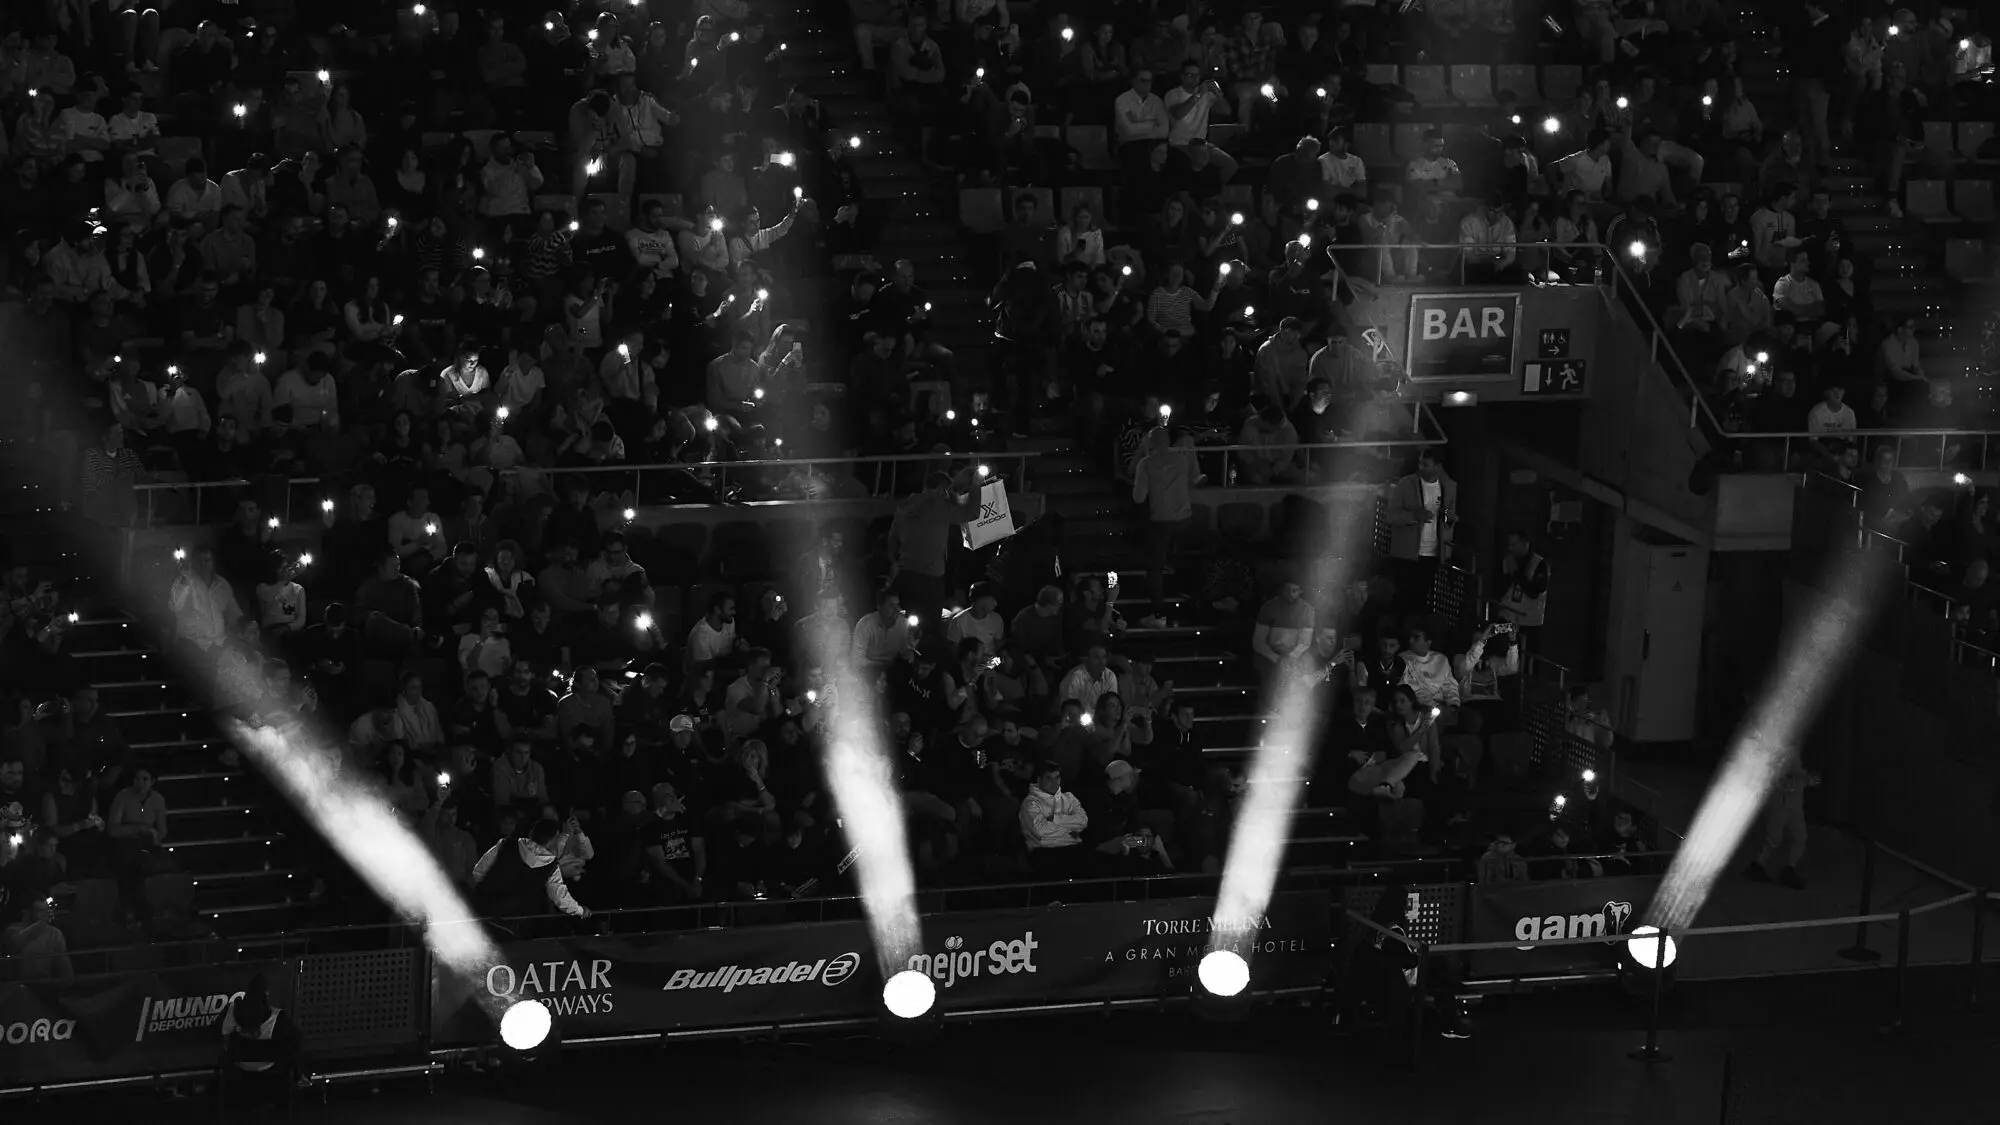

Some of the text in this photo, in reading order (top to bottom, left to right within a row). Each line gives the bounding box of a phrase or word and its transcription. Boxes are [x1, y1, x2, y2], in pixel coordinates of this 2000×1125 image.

[1423, 307, 1507, 341] BAR
[1143, 919, 1201, 936] TORRE
[1105, 951, 1114, 962] A
[1125, 947, 1177, 961] GRAN
[1251, 938, 1308, 953] HOTEL
[486, 959, 613, 1000] QATAR
[662, 959, 826, 993] Bullpadel
